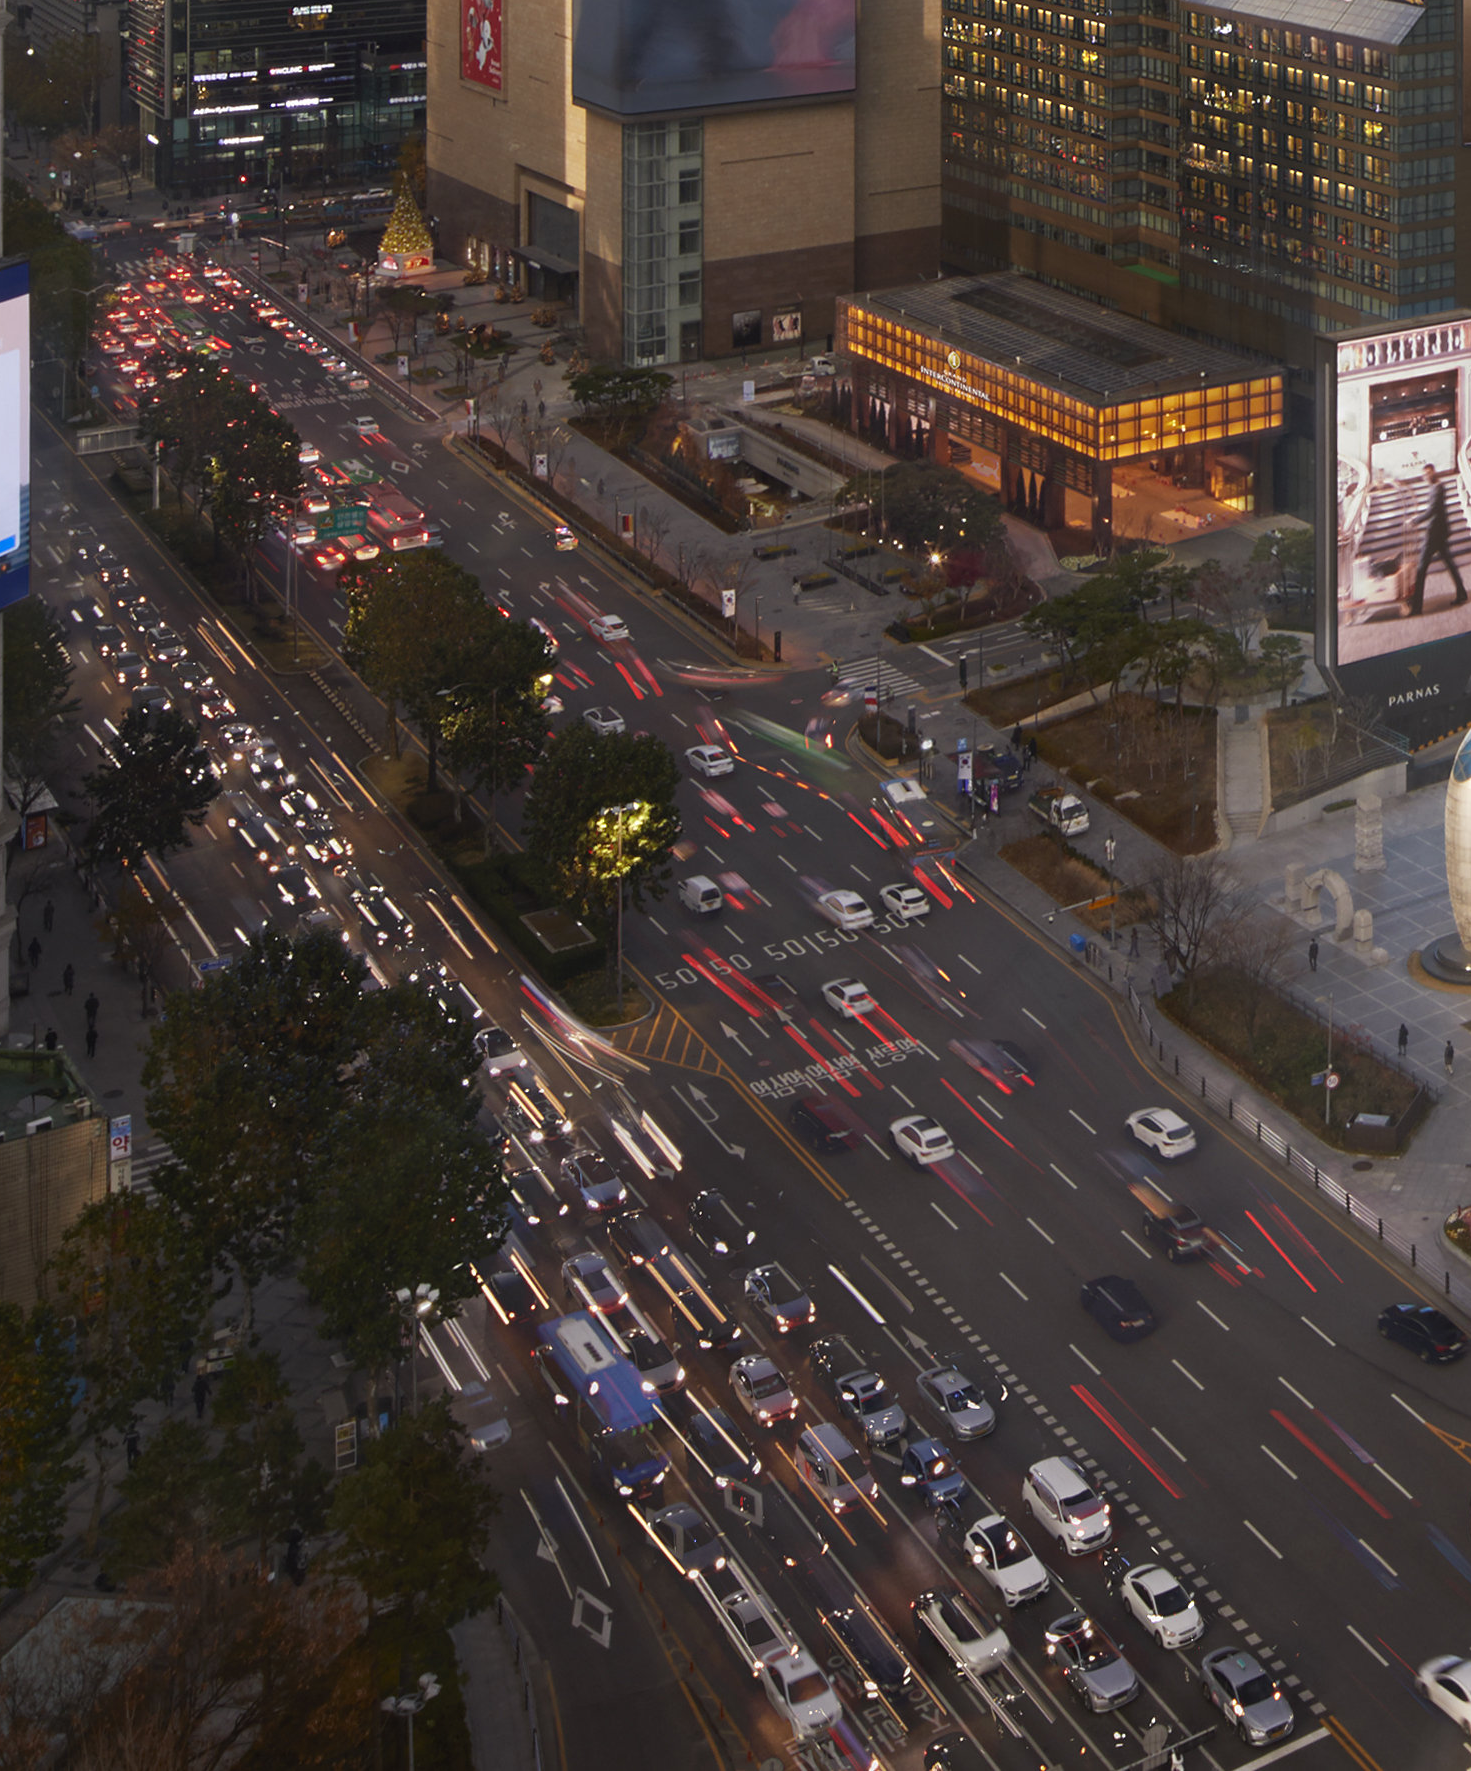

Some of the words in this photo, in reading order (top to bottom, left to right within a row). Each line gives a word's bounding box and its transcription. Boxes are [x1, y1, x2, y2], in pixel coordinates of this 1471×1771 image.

[1388, 683, 1440, 707] PARNAS
[814, 926, 860, 950] 50
[763, 938, 807, 963] 50
[656, 966, 698, 991] 50
